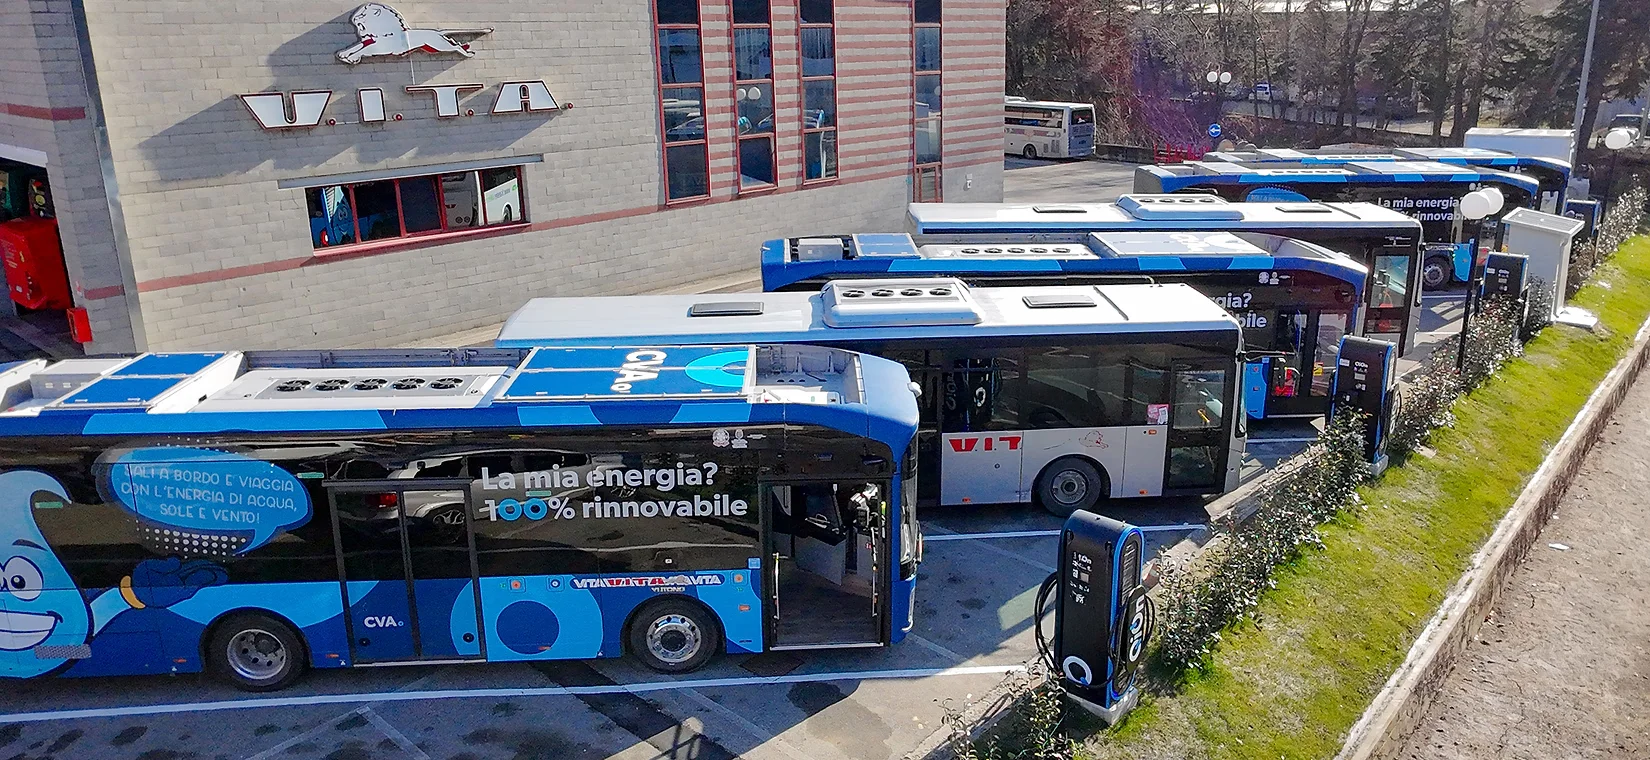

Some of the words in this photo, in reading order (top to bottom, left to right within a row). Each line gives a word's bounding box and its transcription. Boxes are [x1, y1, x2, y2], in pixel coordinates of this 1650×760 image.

[1378, 197, 1391, 208] La
[1393, 196, 1414, 208] mia
[1416, 197, 1464, 210] energia
[124, 464, 155, 479] SALI
[159, 468, 169, 480] A
[174, 470, 220, 485] BORDO
[226, 474, 233, 486] E
[239, 476, 294, 492] VIAGGIA
[481, 466, 516, 490] La
[524, 464, 580, 489] mia
[586, 462, 718, 492] energia?
[121, 483, 150, 496] CON
[154, 485, 225, 503] L'ENERGIA
[229, 493, 242, 505] DI
[247, 496, 297, 512] ACQUA,
[483, 497, 576, 522] 100%
[582, 493, 748, 519] rinnovabile
[160, 504, 194, 519] SOLE
[199, 507, 206, 519] E
[212, 509, 260, 524] VENTO!
[363, 615, 398, 628] CVA
